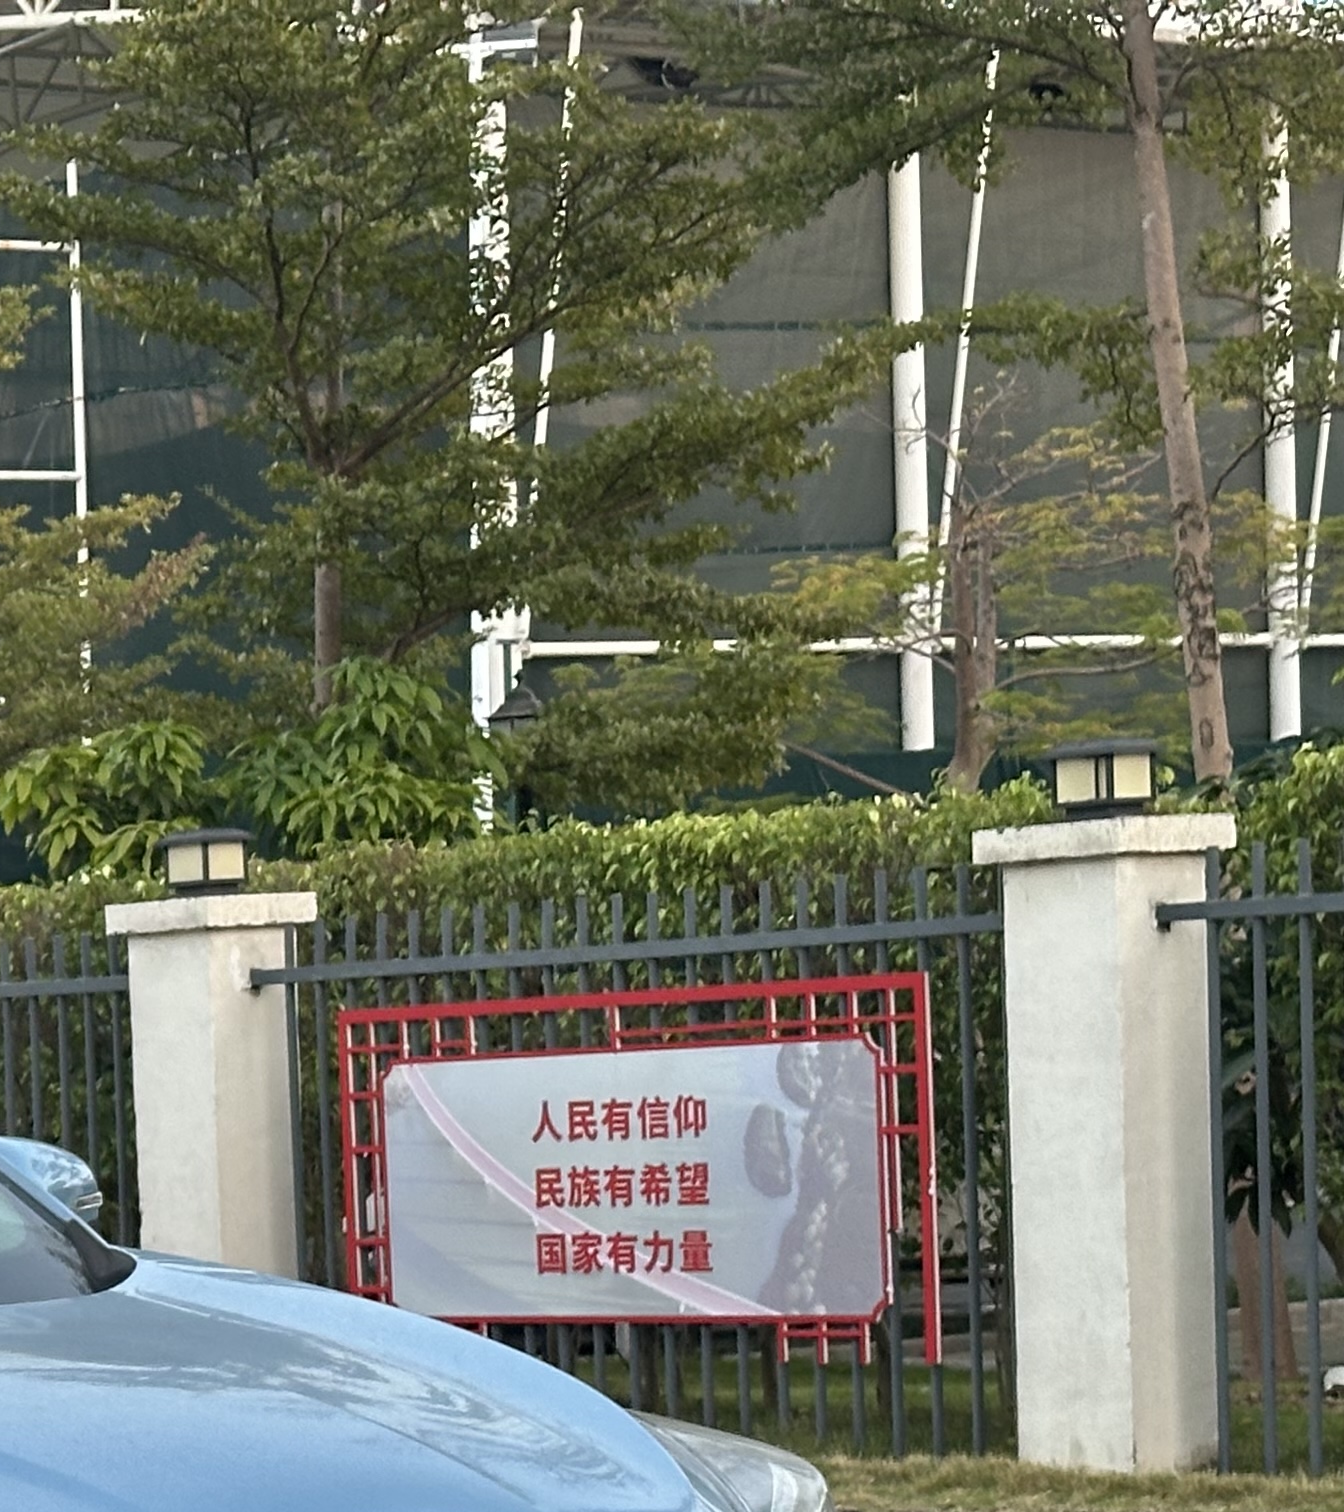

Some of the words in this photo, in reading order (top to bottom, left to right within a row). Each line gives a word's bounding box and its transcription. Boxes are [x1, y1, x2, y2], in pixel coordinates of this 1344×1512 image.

[532, 1095, 708, 1143] 人民有信仰
[534, 1162, 710, 1209] 民族有希望
[536, 1230, 714, 1275] 国家有力量
